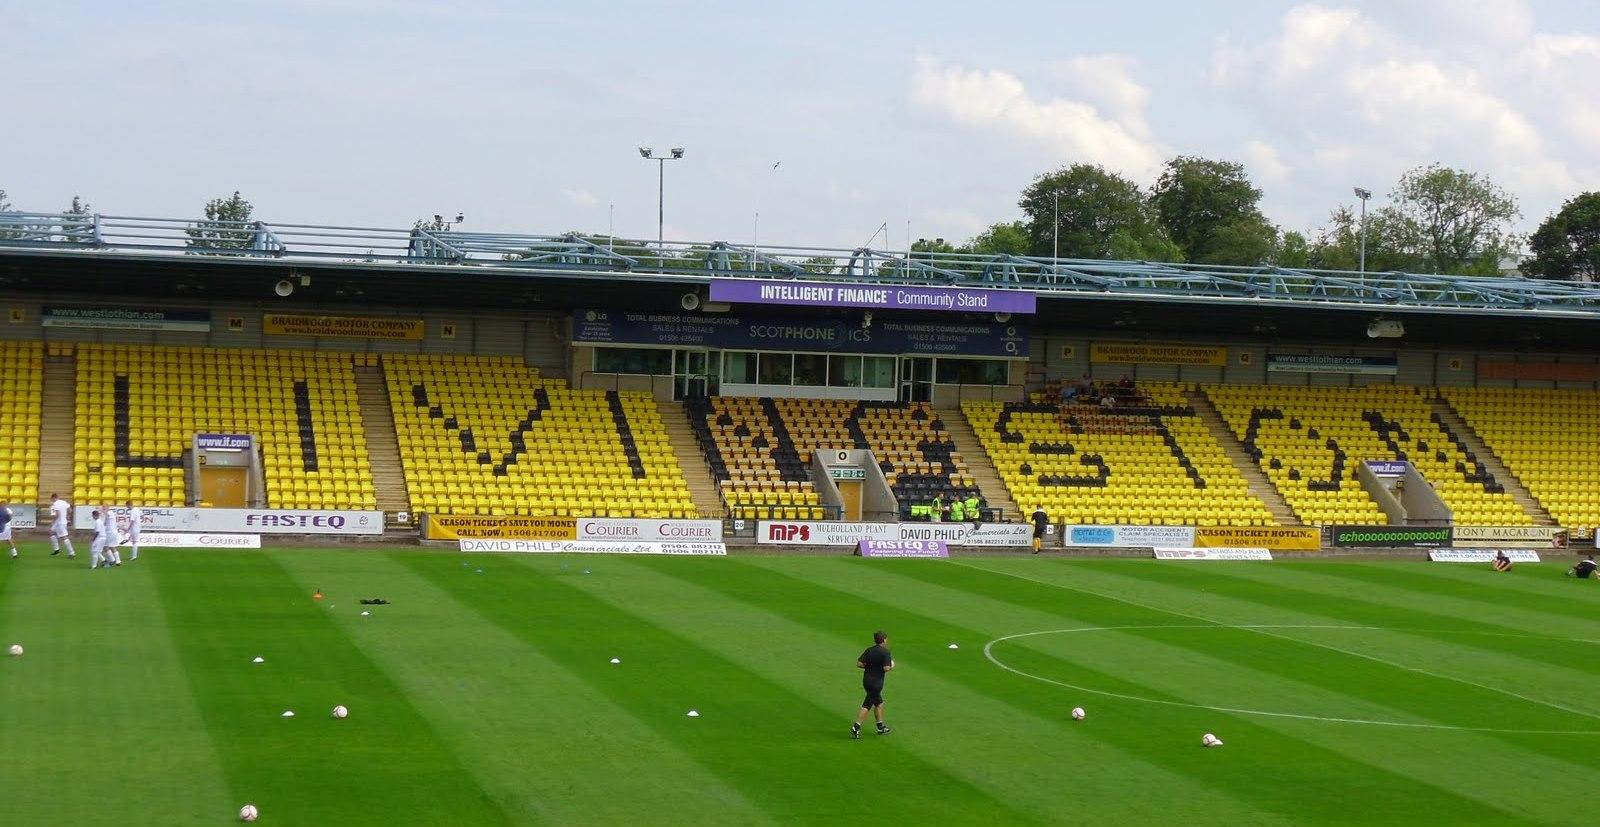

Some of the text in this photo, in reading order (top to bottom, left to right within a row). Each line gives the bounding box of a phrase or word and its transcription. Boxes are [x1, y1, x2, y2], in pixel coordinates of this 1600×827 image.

[761, 285, 833, 300] INTELLIGENT
[897, 290, 955, 308] Community
[957, 292, 988, 307] Stand
[231, 319, 242, 328] M
[271, 317, 417, 331] BRAIDWOOD MOTOR COMPANY
[626, 314, 740, 325] TOTAL BUSINESS COMMUNICATIONS
[443, 326, 453, 336] N
[1098, 346, 1218, 358] BRAIDWOOD MOTOR COMPANY
[198, 437, 250, 447] www.if.com
[246, 514, 346, 530] FASTEQ
[439, 519, 577, 528] SEASON TICKETS SAVE YOU MONEY
[457, 529, 477, 537] CALL
[769, 525, 809, 541] MPS
[816, 524, 887, 534] MULHOLLAND PLANT
[1196, 529, 1232, 537] SEASON
[1456, 529, 1486, 537] TONY
[827, 535, 857, 543] SERVICES
[900, 529, 931, 540] DAVID
[934, 529, 964, 541] PHILP
[462, 541, 511, 550] DAVID
[515, 542, 561, 551] PHILP
[868, 541, 923, 550] FASTEQ
